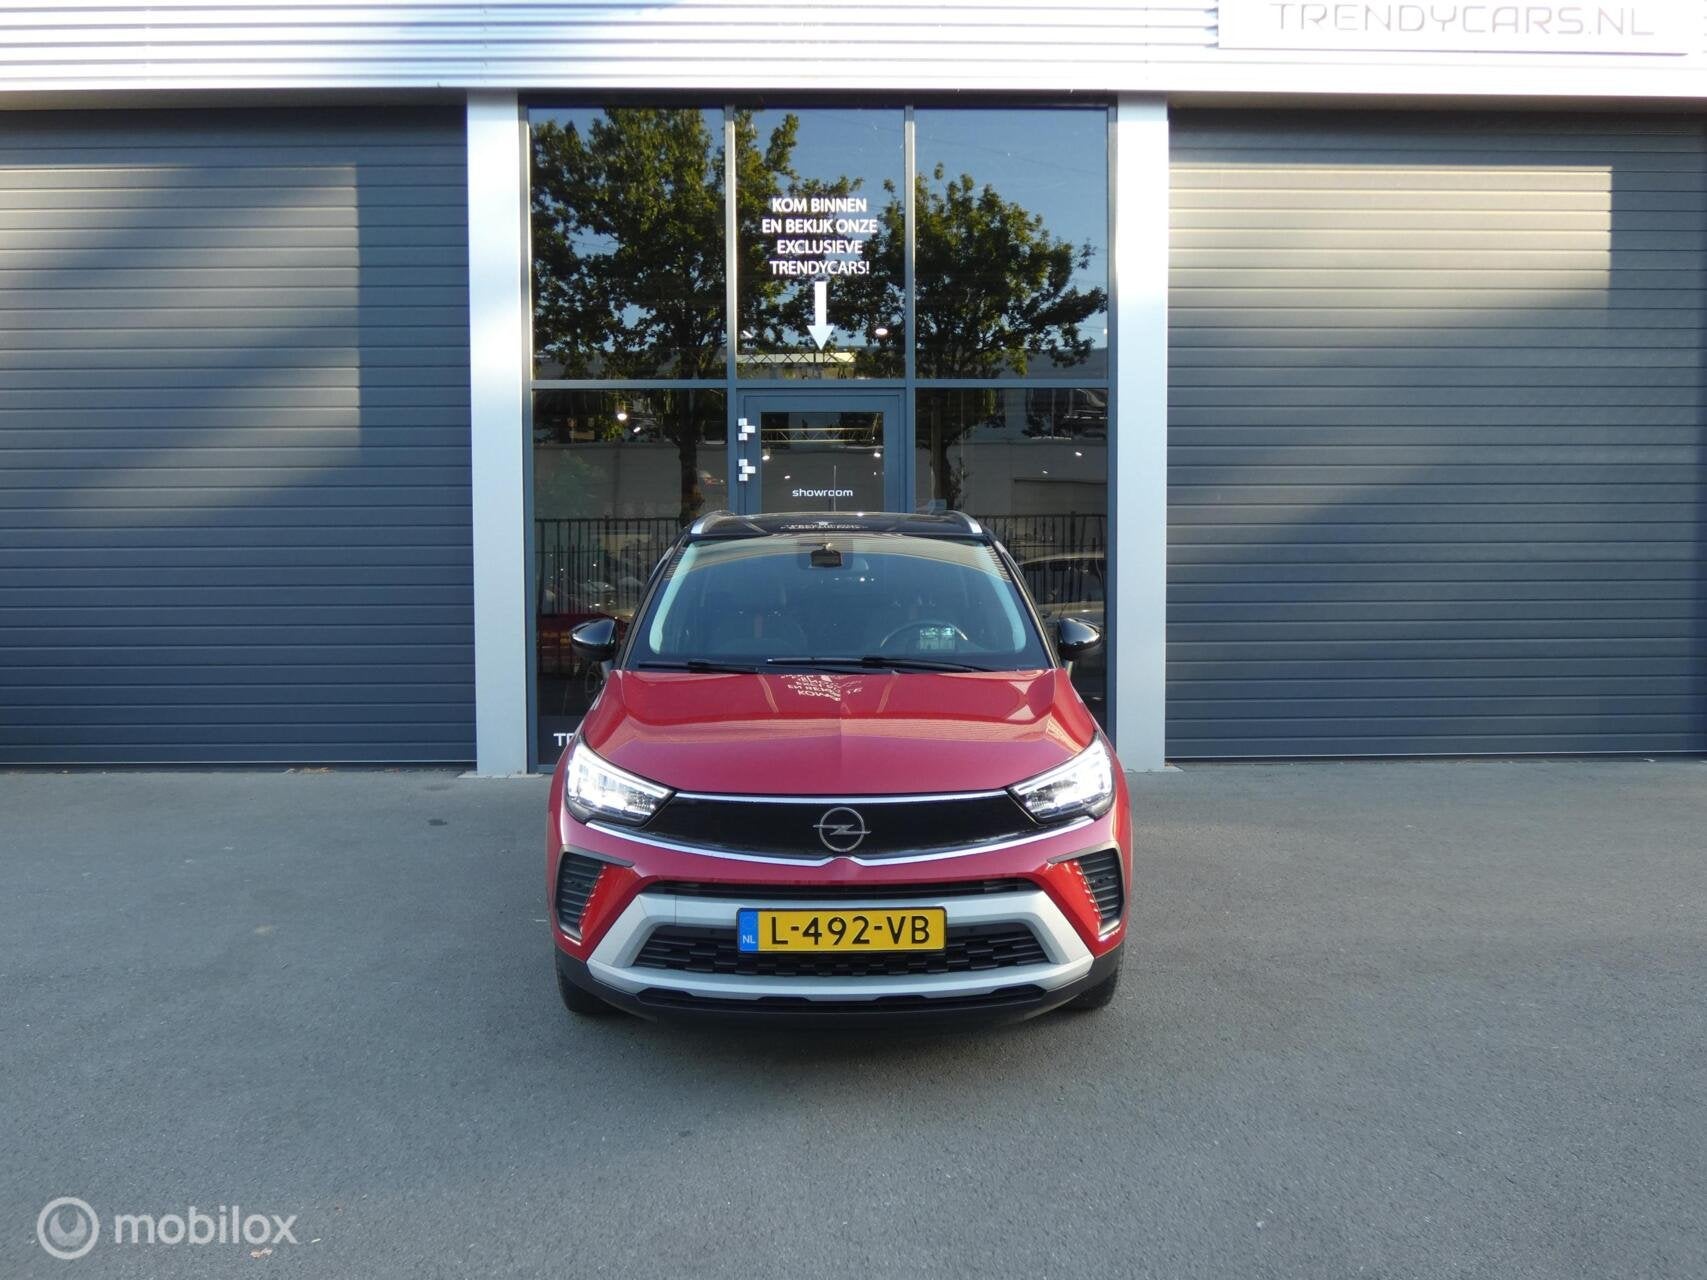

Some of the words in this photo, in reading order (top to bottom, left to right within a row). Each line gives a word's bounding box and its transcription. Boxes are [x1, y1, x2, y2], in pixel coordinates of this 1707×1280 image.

[1269, 2, 1655, 36] TRENDYCARS.NL
[772, 198, 807, 213] KOM
[811, 198, 867, 213] BINNEN
[762, 219, 781, 233] EN
[786, 219, 833, 233] BEKIJK
[836, 219, 878, 233] ONZE
[777, 240, 863, 254] EXCLUSIEVE
[769, 261, 870, 275] TRENDYCARS!
[792, 488, 853, 497] showroom
[771, 915, 930, 945] L-492-VB
[742, 935, 756, 944] NL
